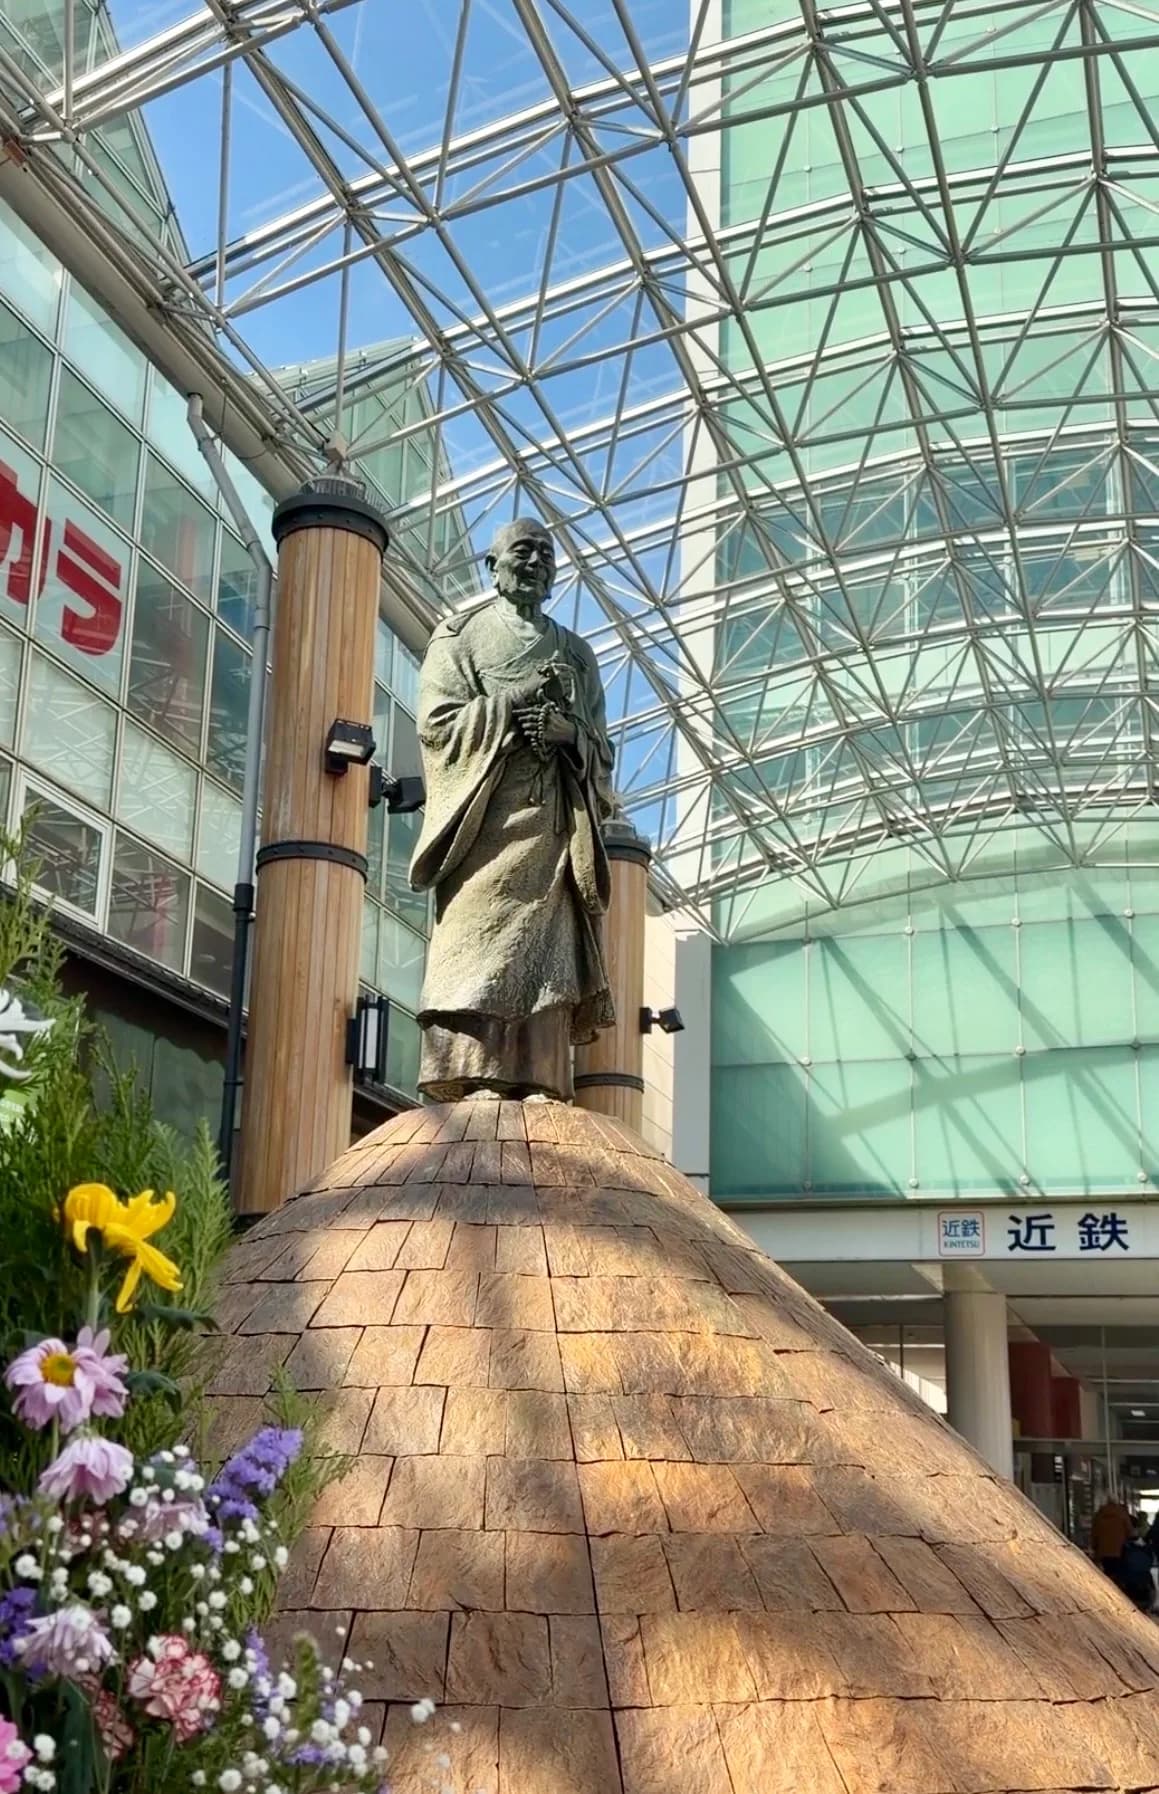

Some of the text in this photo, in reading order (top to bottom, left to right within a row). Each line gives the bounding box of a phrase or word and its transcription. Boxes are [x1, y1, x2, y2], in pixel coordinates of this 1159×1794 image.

[942, 1219, 980, 1237] 近鉄
[1007, 1212, 1129, 1251] 近鉄
[943, 1240, 979, 1248] KINTETSU
